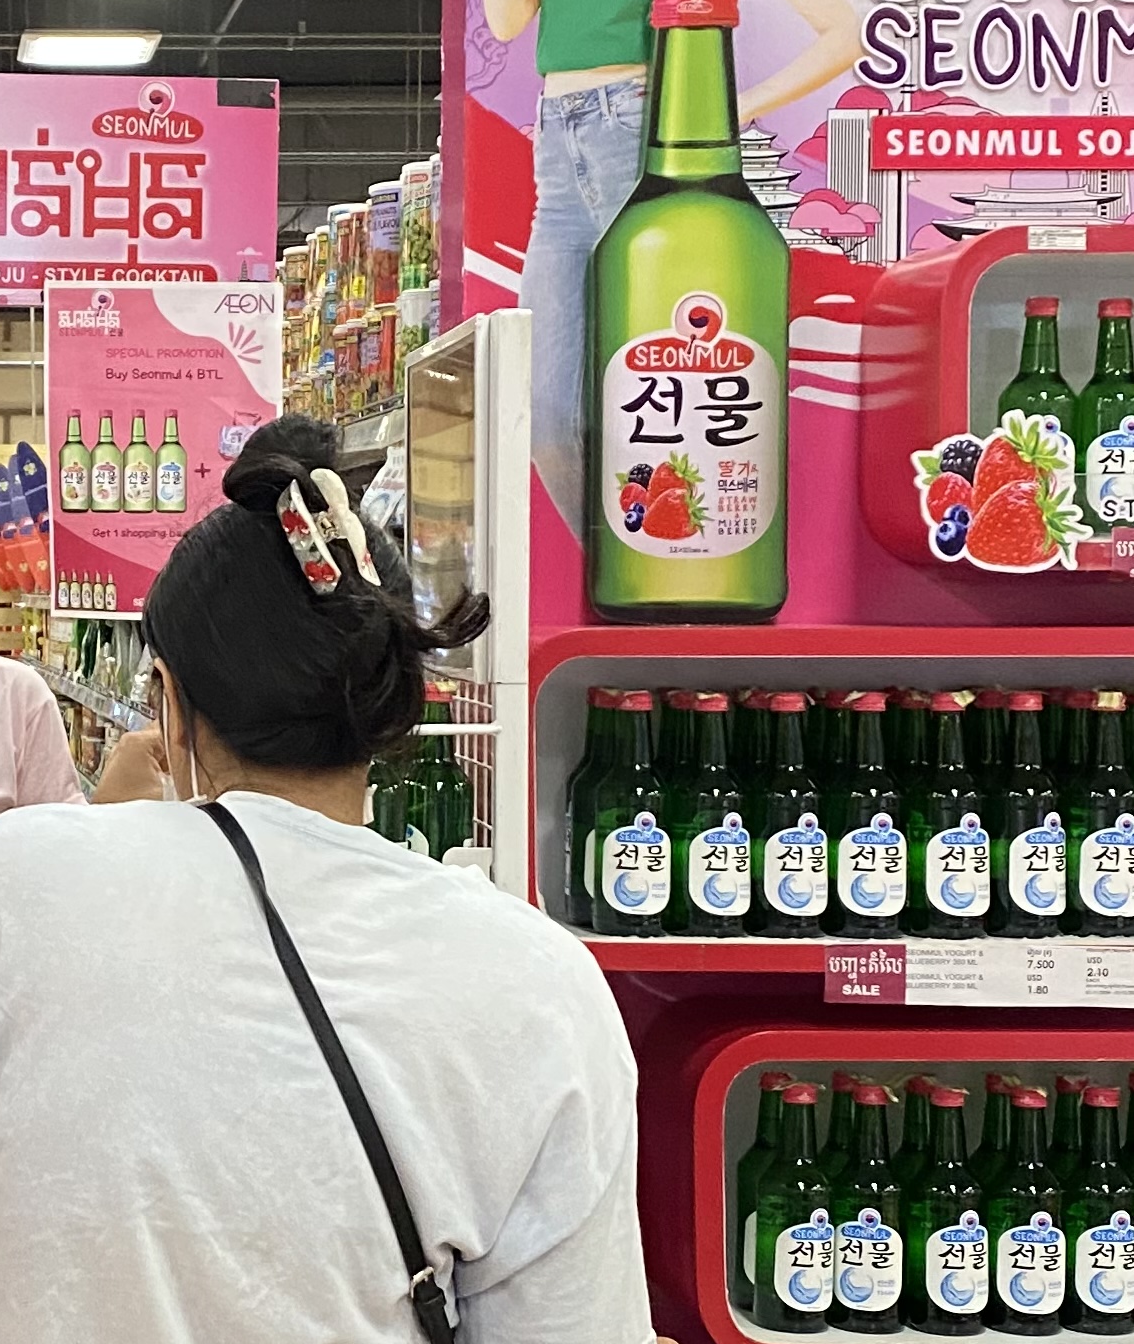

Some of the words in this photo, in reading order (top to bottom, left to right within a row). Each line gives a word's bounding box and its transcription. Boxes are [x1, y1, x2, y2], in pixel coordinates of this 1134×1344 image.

[100, 113, 196, 139] SEONMUL
[887, 128, 1062, 156] SEONMUL
[106, 348, 153, 358] SPECIAL
[157, 348, 224, 359] PROMOTION
[633, 345, 745, 369] SEONMUL
[105, 369, 128, 381] Buy
[132, 369, 182, 380] Seonmul
[185, 369, 193, 380] 4
[197, 369, 224, 380] BTL
[621, 375, 763, 447] 선물
[92, 528, 111, 537] Get
[121, 528, 166, 540] shopping
[169, 528, 184, 538] ba
[613, 844, 666, 872] 선물
[702, 845, 750, 872] 선물
[777, 846, 826, 873] 선물
[849, 846, 903, 873] 선물
[939, 846, 988, 873] 선물
[1087, 956, 1103, 964] USD
[1087, 967, 1109, 977] 2.10
[842, 984, 881, 996] SALE
[1027, 974, 1042, 982] USD
[1028, 985, 1049, 995] 1.80
[788, 1241, 833, 1268] 선물
[839, 1239, 894, 1268] 선물
[938, 1243, 986, 1270] 선물
[1008, 1244, 1061, 1271] 선물
